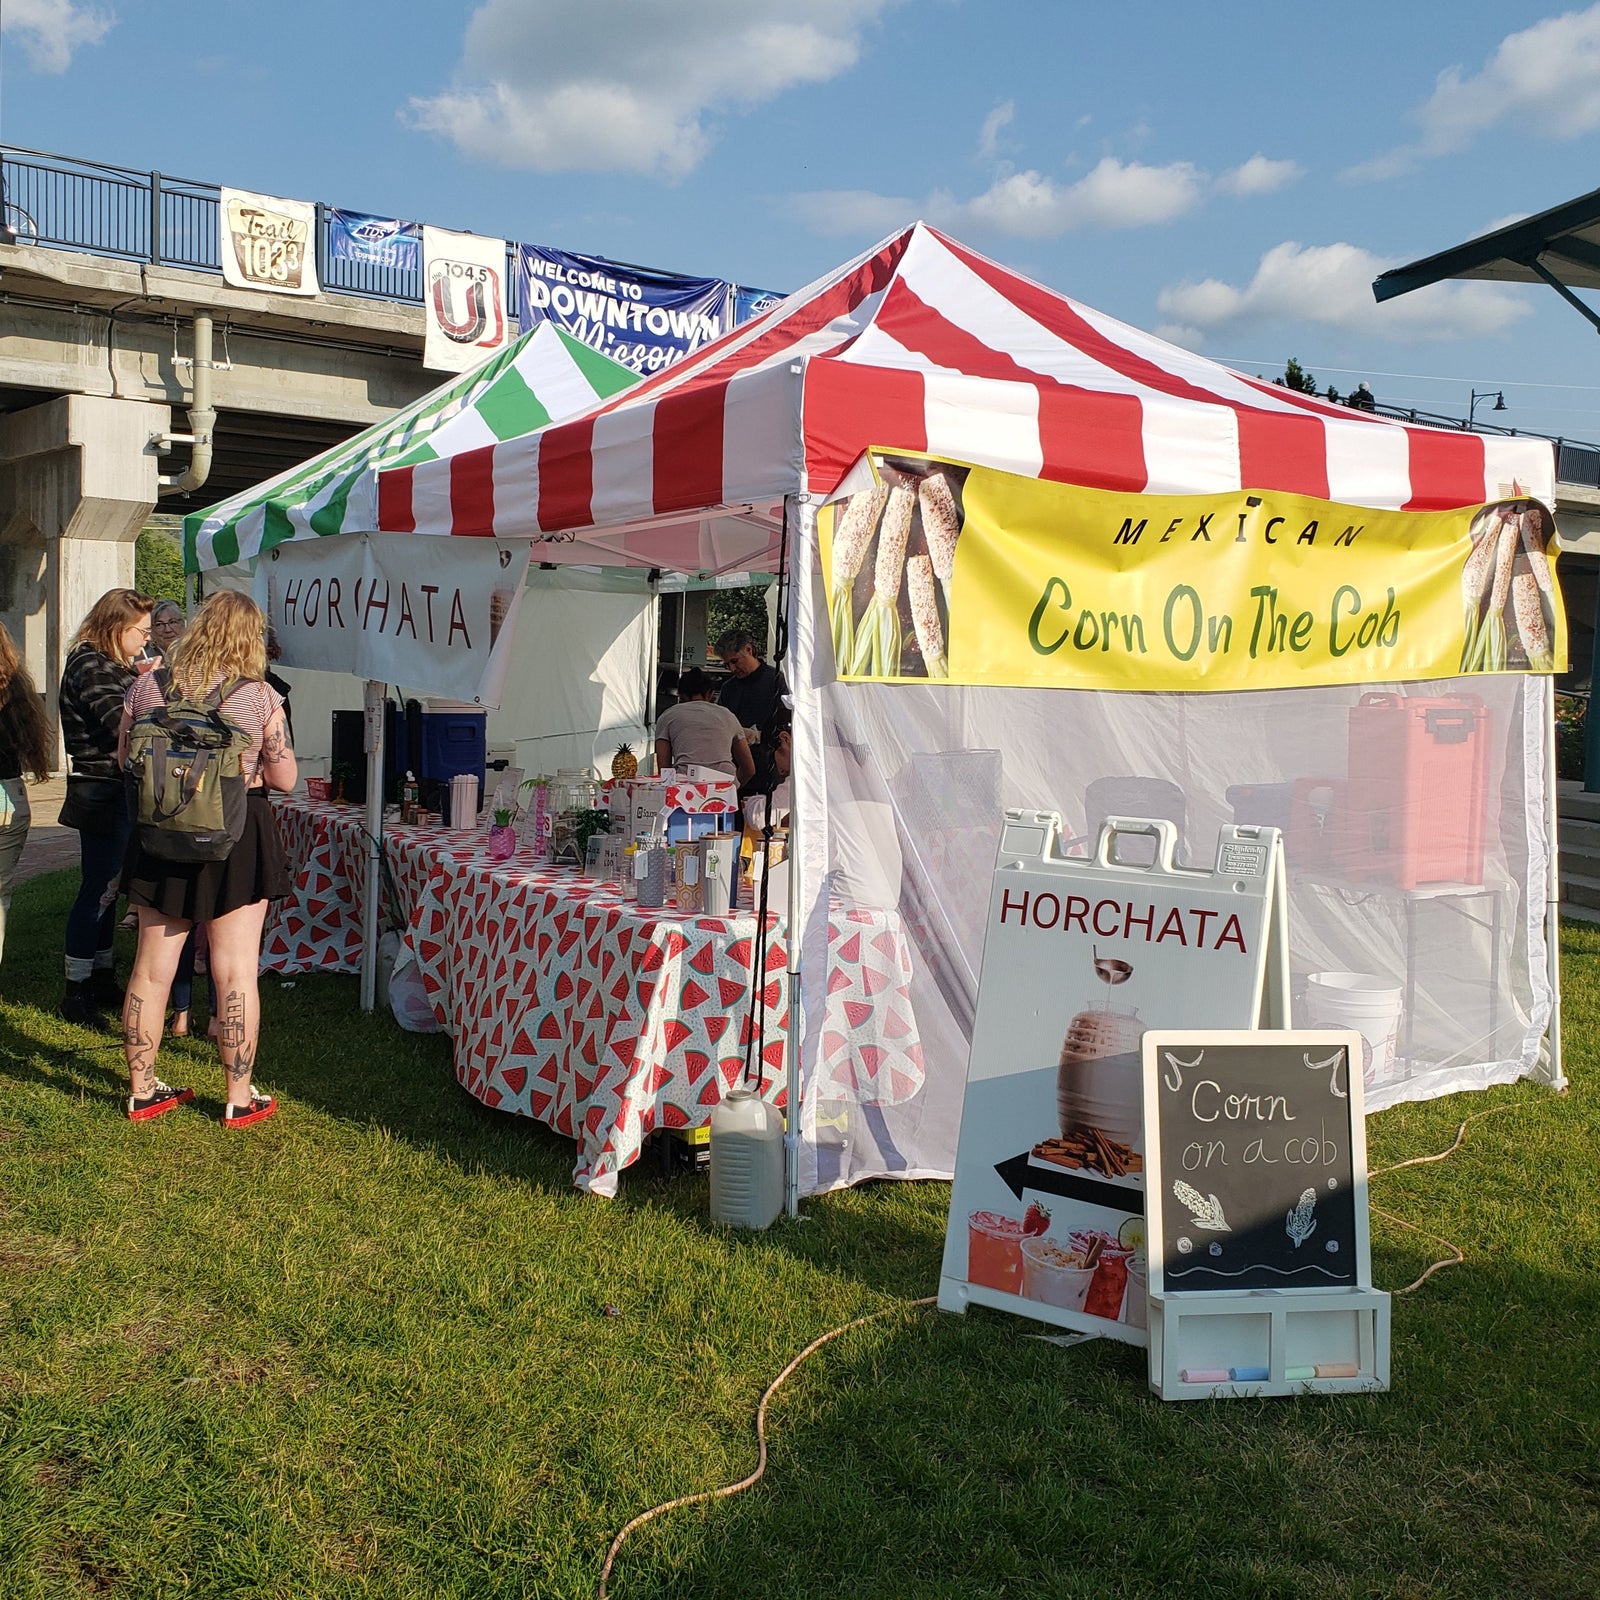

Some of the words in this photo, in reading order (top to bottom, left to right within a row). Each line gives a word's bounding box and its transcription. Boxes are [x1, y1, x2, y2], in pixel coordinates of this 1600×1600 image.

[240, 208, 297, 240] Trail
[363, 225, 386, 239] TDS
[431, 271, 443, 282] the
[444, 262, 487, 283] 104.5
[528, 256, 616, 295] WELCOME
[619, 281, 643, 301] TO
[530, 276, 720, 341] DOWNTOWN
[1113, 512, 1364, 547] MEXICAN
[1028, 576, 1148, 656] Corn
[1163, 583, 1232, 661] On
[1249, 585, 1314, 659] The
[1329, 584, 1401, 658] Cob
[1000, 888, 1247, 953] HORCHATA
[1191, 1080, 1296, 1122] Corn
[1182, 1140, 1229, 1171] on
[1243, 1138, 1278, 1164] a
[1284, 1116, 1338, 1168] cob
